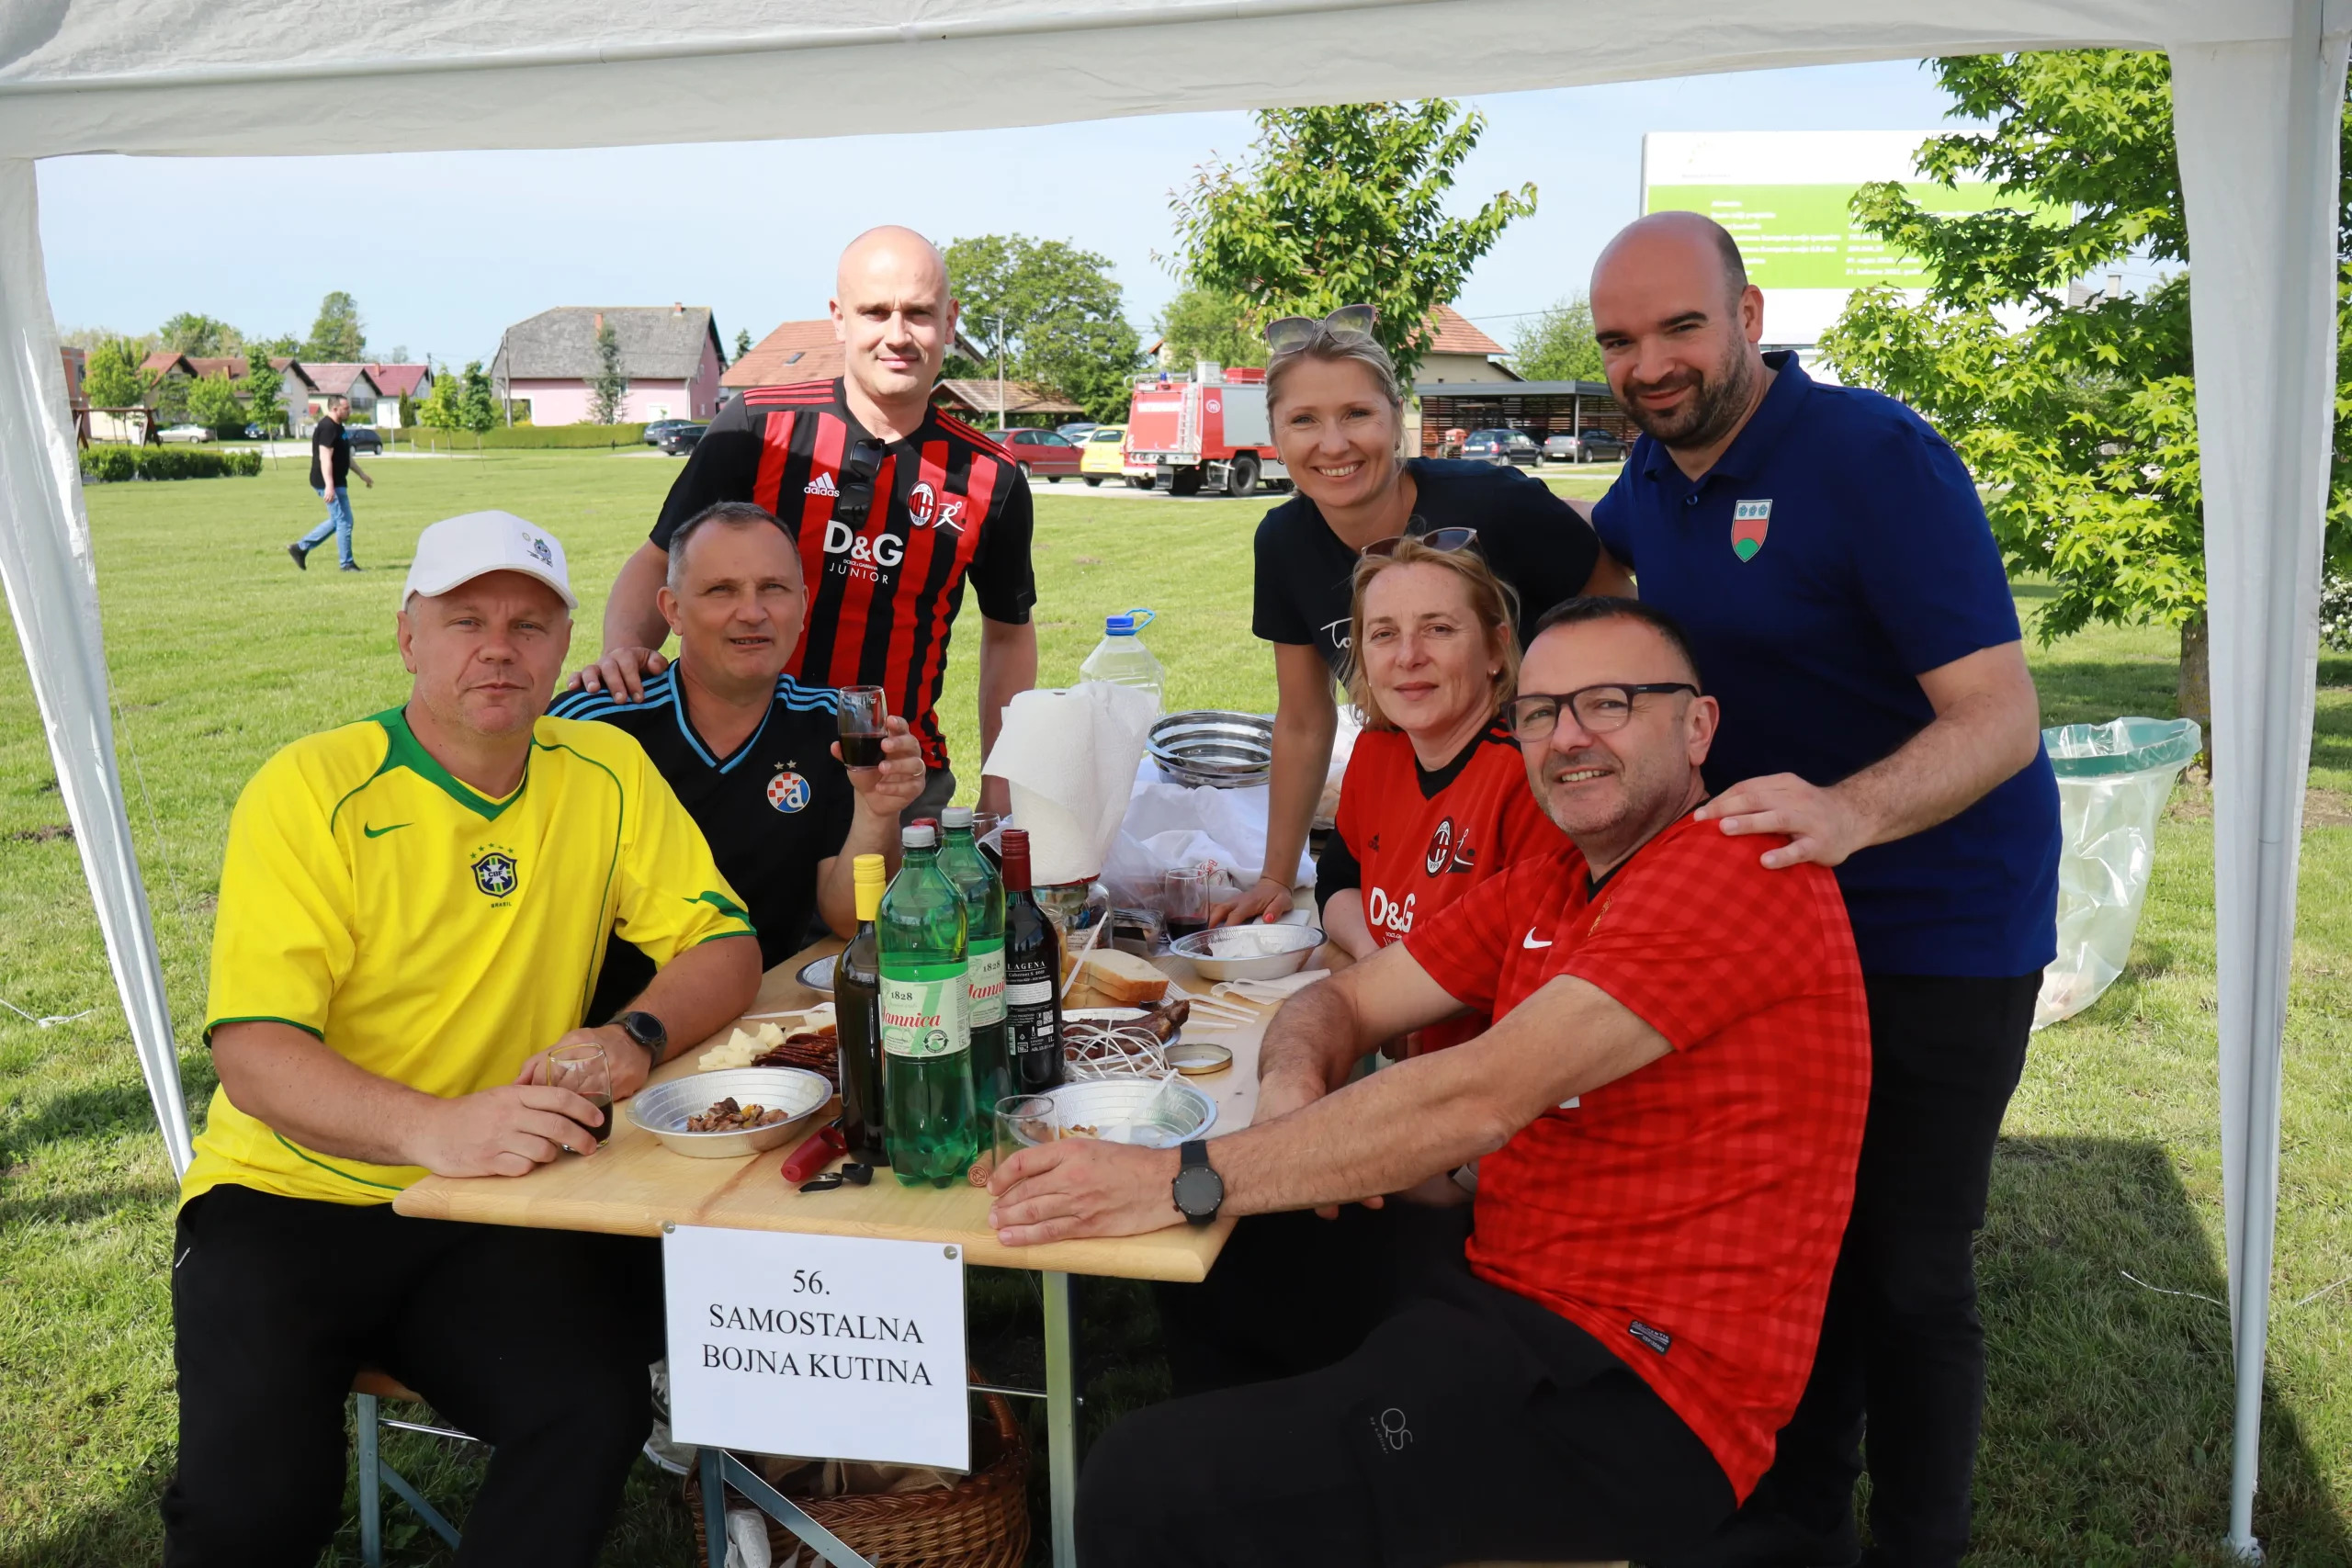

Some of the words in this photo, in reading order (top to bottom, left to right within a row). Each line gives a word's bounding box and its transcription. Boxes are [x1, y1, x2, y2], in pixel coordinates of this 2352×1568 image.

[804, 485, 840, 498] adidas
[823, 520, 904, 567] D&G
[829, 562, 888, 584] JUNIOR
[1369, 886, 1416, 933] D&G
[983, 960, 1001, 973] 1828
[1007, 961, 1046, 970] LAGENA
[891, 991, 913, 1001] 1828
[882, 1006, 941, 1028] Jamnica
[793, 1269, 831, 1295] 56.
[709, 1303, 924, 1345] SAMOSTALNA
[702, 1344, 801, 1377] BOJNA
[809, 1354, 933, 1387] KUTINA
